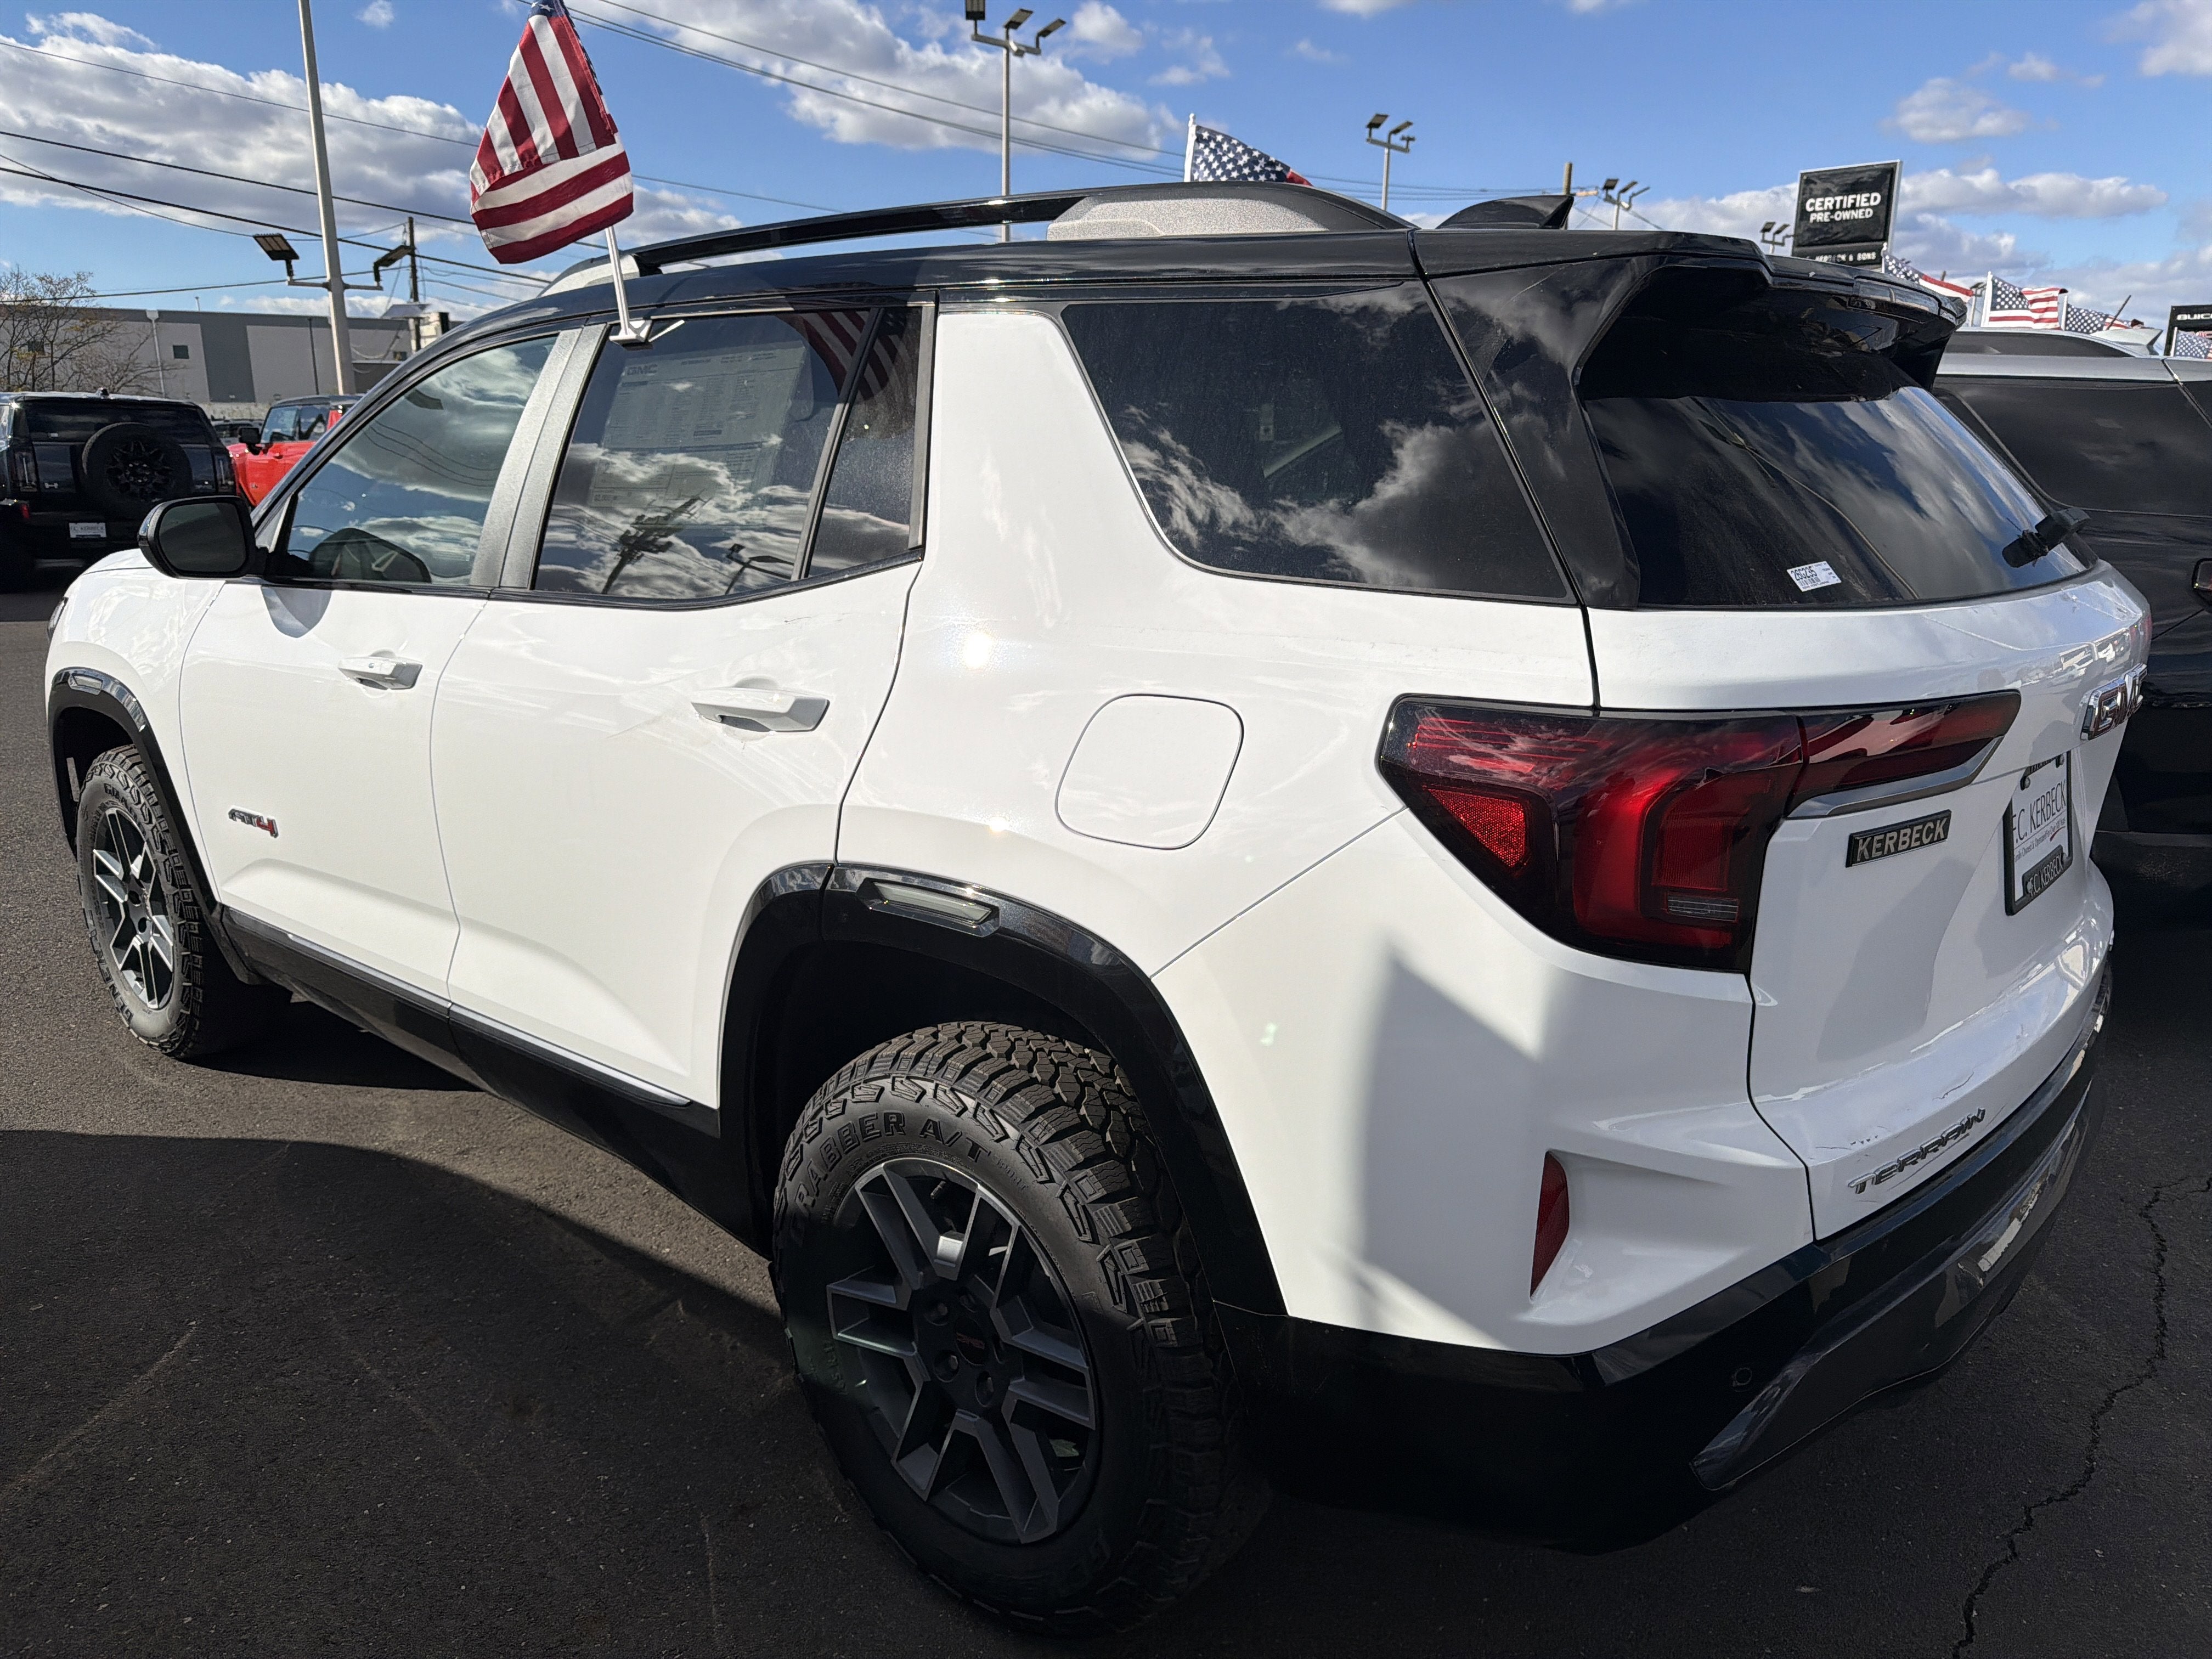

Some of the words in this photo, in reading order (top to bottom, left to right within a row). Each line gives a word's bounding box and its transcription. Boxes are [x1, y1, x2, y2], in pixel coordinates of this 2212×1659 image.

[1805, 192, 1881, 212] CERTIFIED
[1809, 207, 1874, 223] PRE-OWNED
[2030, 778, 2066, 832] KERBECK
[1857, 817, 1948, 861] KERBECK
[2040, 851, 2063, 889] KERBECK
[919, 1118, 992, 1164] A/T
[1848, 1107, 1986, 1194] TERRAIN
